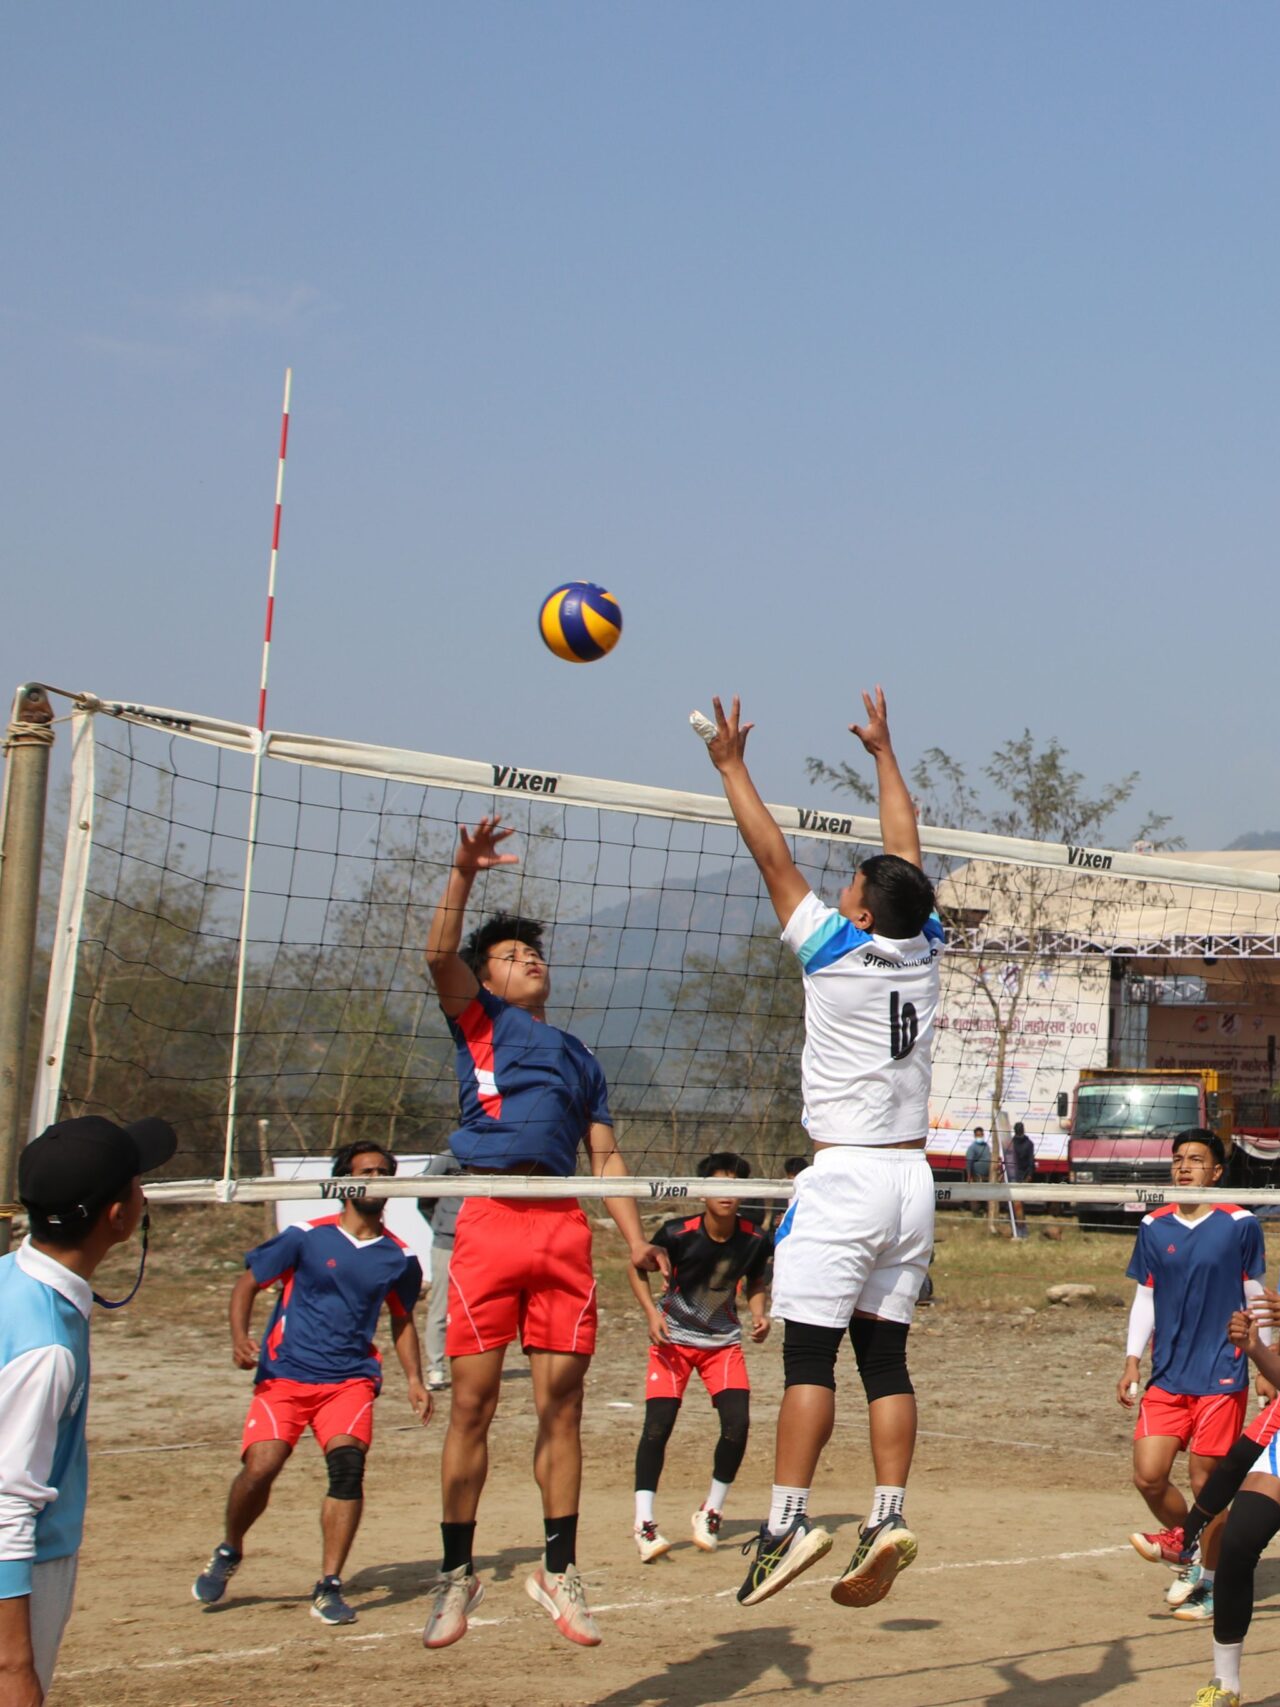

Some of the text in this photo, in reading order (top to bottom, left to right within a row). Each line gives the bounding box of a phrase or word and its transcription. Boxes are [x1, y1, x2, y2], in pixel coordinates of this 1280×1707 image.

[492, 765, 558, 793] Vixen
[797, 808, 852, 834] Vixen
[1067, 846, 1112, 870] Vixen
[319, 1181, 367, 1200] Vixen
[649, 1182, 689, 1199] Vixen
[1136, 1189, 1165, 1203] Vixen
